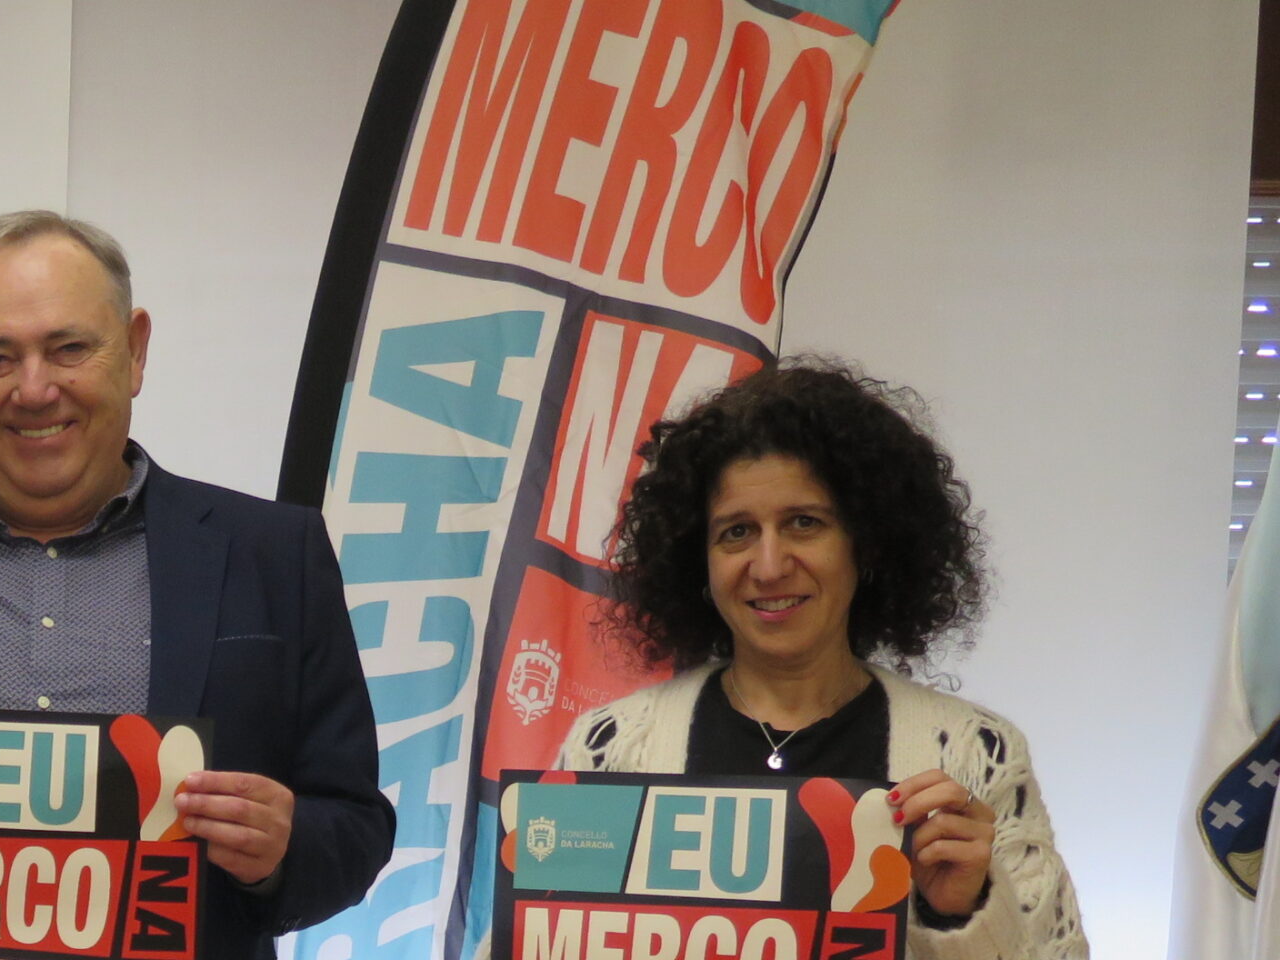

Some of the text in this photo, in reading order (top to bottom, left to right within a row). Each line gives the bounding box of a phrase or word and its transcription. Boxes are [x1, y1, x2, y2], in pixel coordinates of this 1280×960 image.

[403, 0, 833, 325] MERCO
[646, 794, 773, 894] EU
[131, 855, 191, 952] NA
